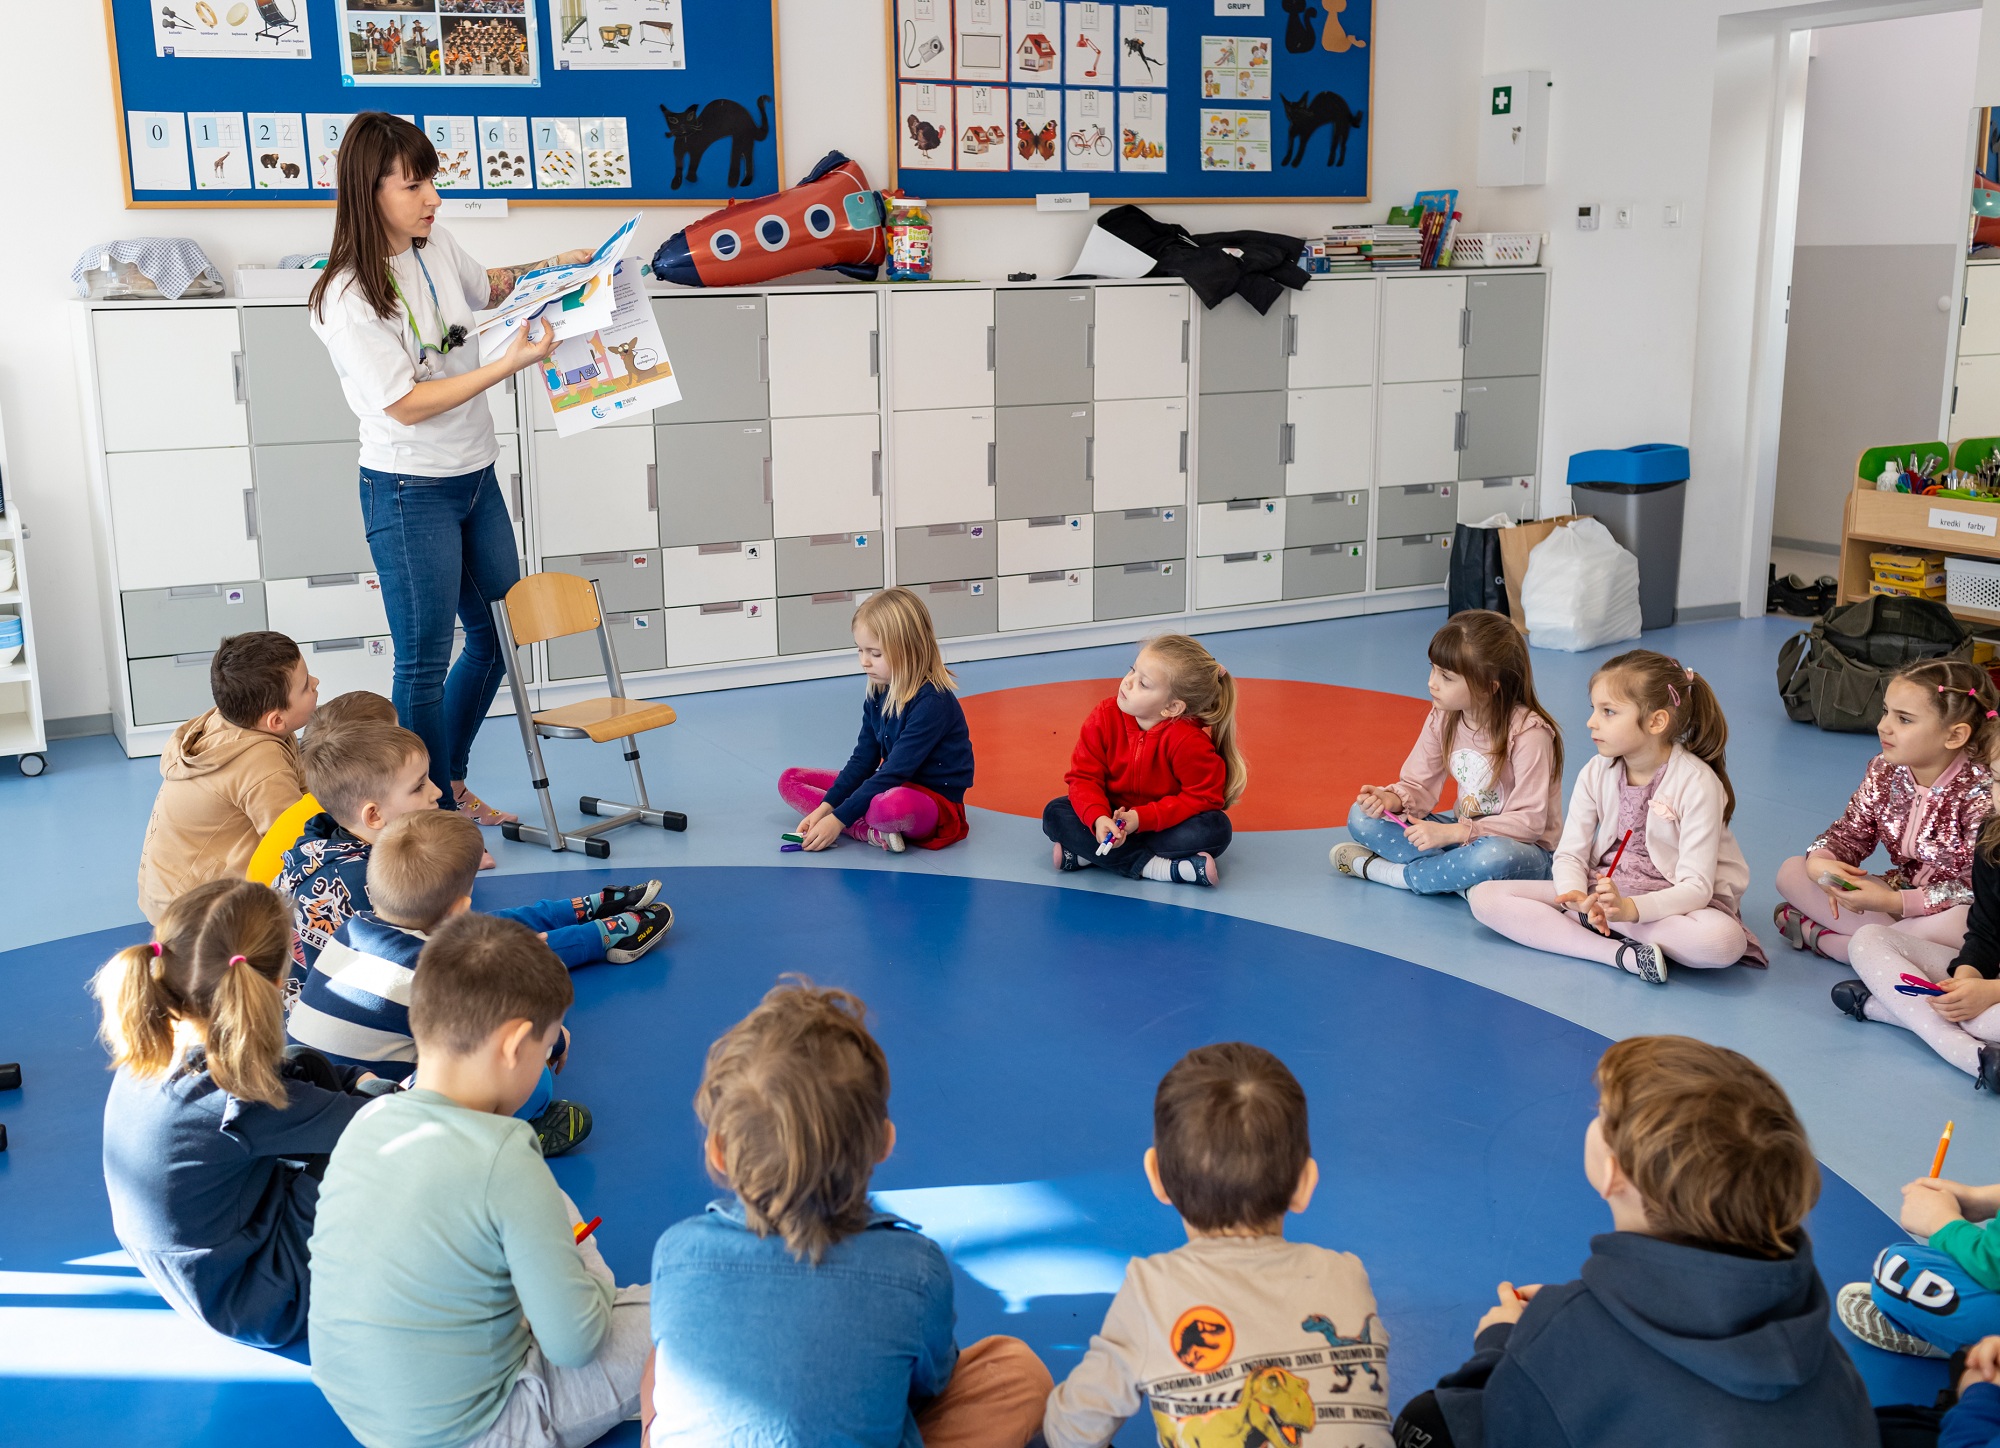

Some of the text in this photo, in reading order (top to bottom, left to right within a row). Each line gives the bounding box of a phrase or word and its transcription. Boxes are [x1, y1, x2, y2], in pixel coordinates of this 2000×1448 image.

[1029, 1, 1042, 9] dD
[1137, 7, 1150, 15] nN
[976, 88, 987, 98] yY
[1028, 89, 1044, 99] mM
[1084, 91, 1095, 100] rR
[1137, 94, 1148, 102] sS
[152, 124, 163, 141] 0
[202, 124, 211, 141] 1
[259, 124, 271, 141] 2
[328, 125, 339, 141] 3
[436, 127, 445, 143] 5
[488, 127, 498, 143] 6
[541, 128, 551, 143] 7
[590, 127, 600, 143] 8
[464, 201, 482, 210] cyfry
[1940, 518, 1986, 532] kredki farby
[1152, 1375, 1203, 1394] INCOMING
[1329, 1347, 1373, 1362] INCOMING
